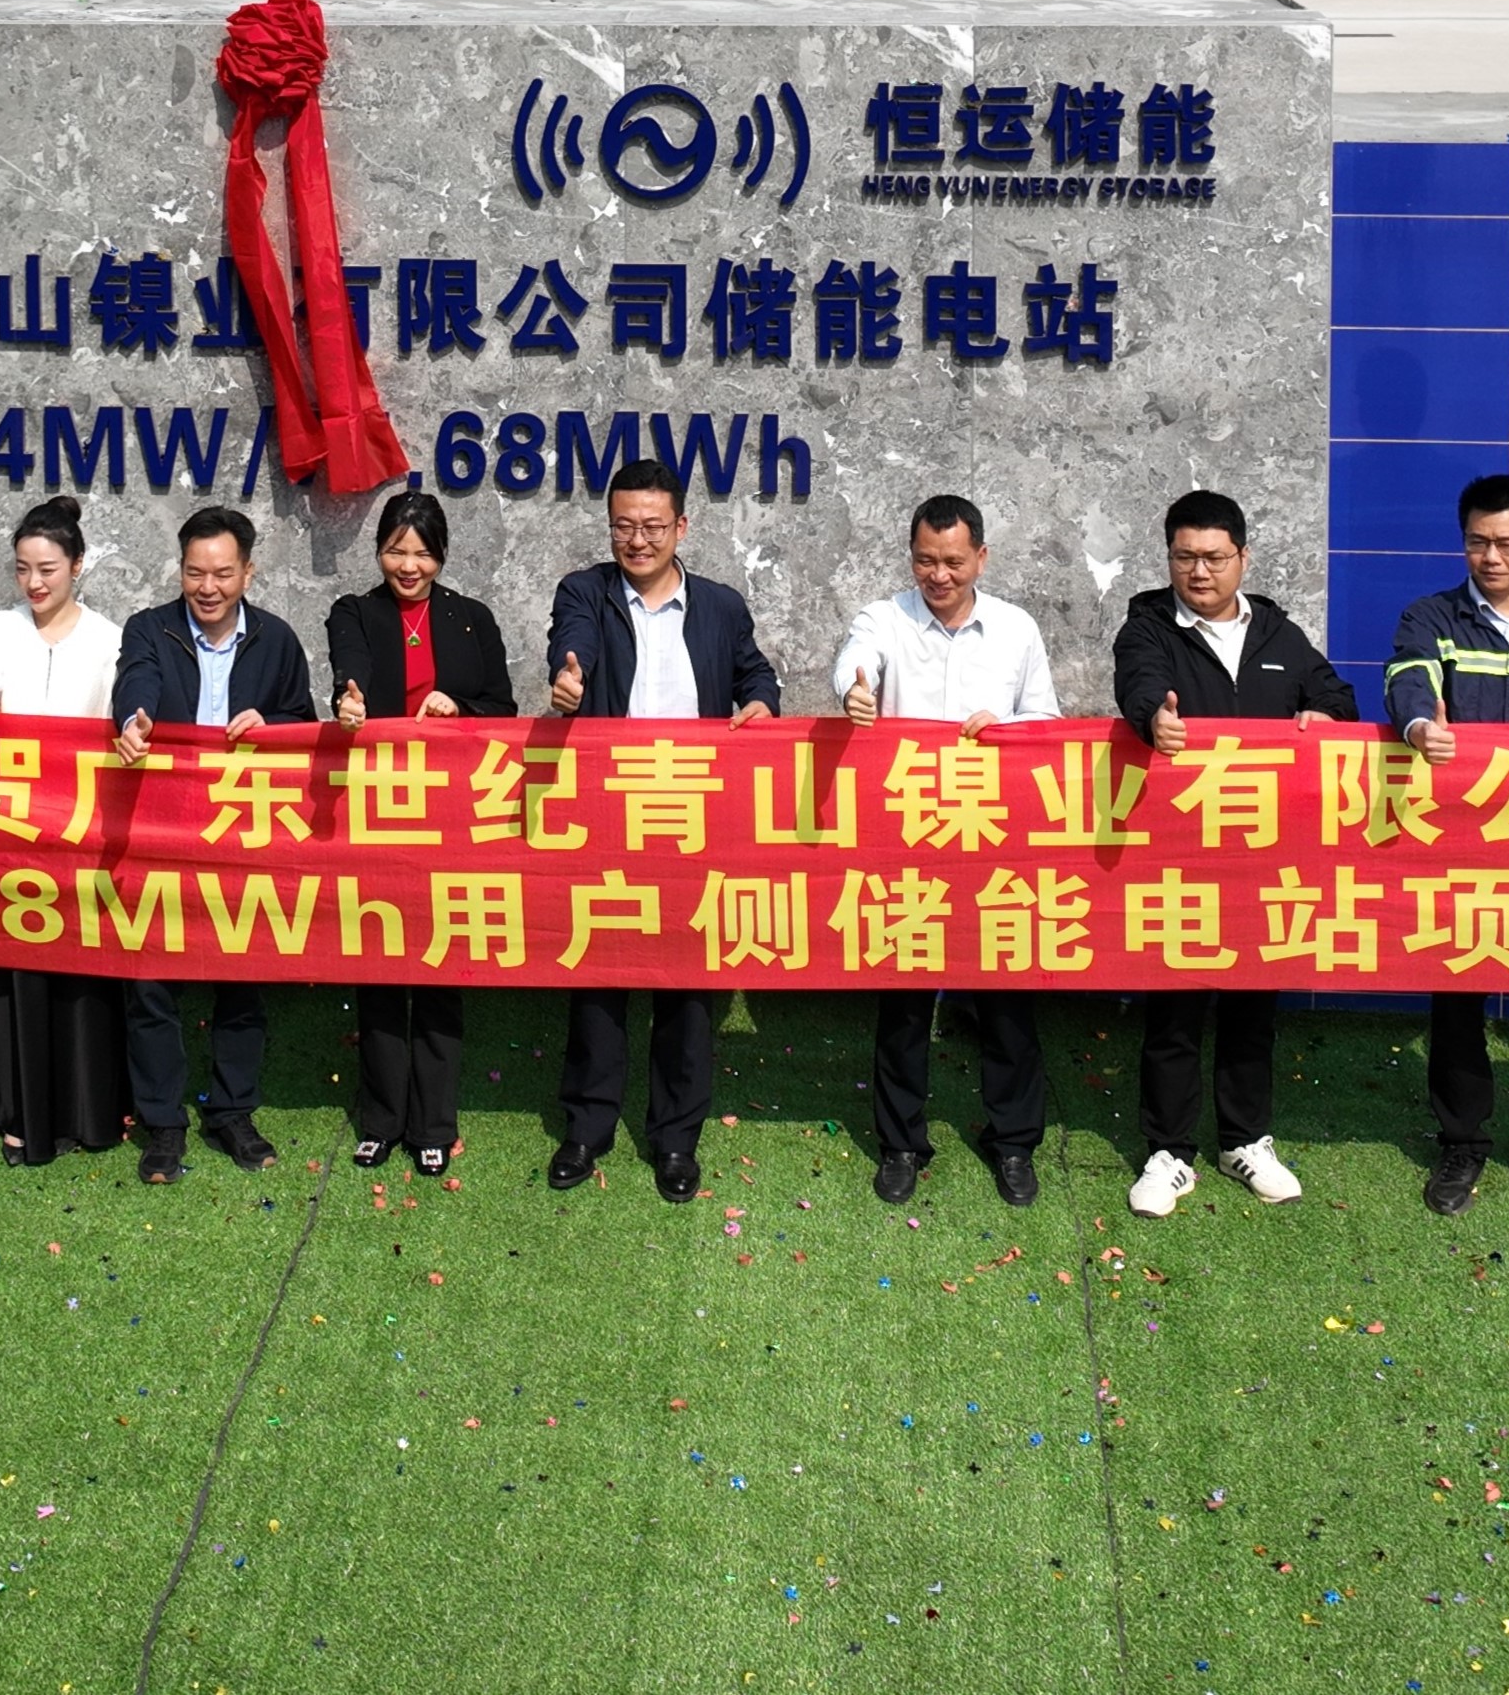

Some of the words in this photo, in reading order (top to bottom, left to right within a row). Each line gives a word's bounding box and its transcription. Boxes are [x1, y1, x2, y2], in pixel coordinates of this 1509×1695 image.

[867, 82, 1217, 165] 恒运储能
[863, 175, 931, 197] HENG
[938, 176, 990, 197] YUN
[995, 176, 1094, 198] ENERGY
[1100, 177, 1217, 199] STORAGE
